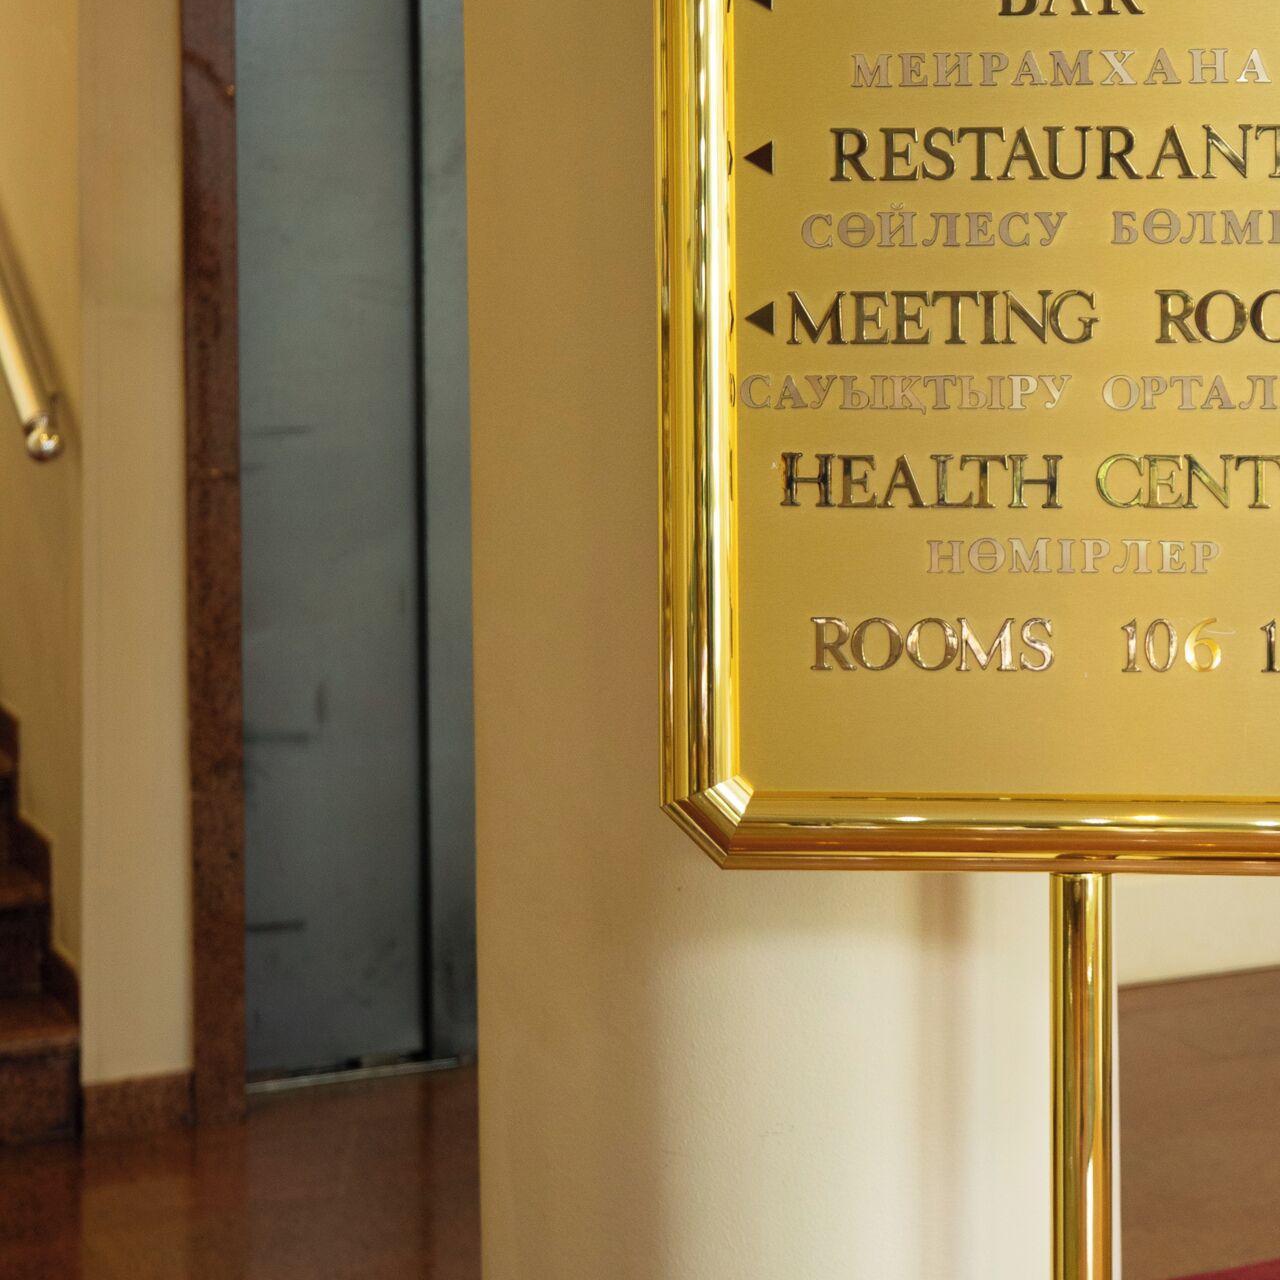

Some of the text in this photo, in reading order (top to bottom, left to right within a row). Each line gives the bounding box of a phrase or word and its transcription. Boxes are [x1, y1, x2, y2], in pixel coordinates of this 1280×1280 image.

[801, 202, 1068, 249] СӨЙЛЕСУ
[786, 289, 1099, 346] MEETING
[739, 374, 1073, 416] САУЫҚТЫРУ
[779, 451, 1063, 510] HEALTH
[926, 537, 1221, 575] НӨМІРЛЕР
[810, 616, 1056, 674] ROOMS
[1119, 617, 1223, 674] 106
